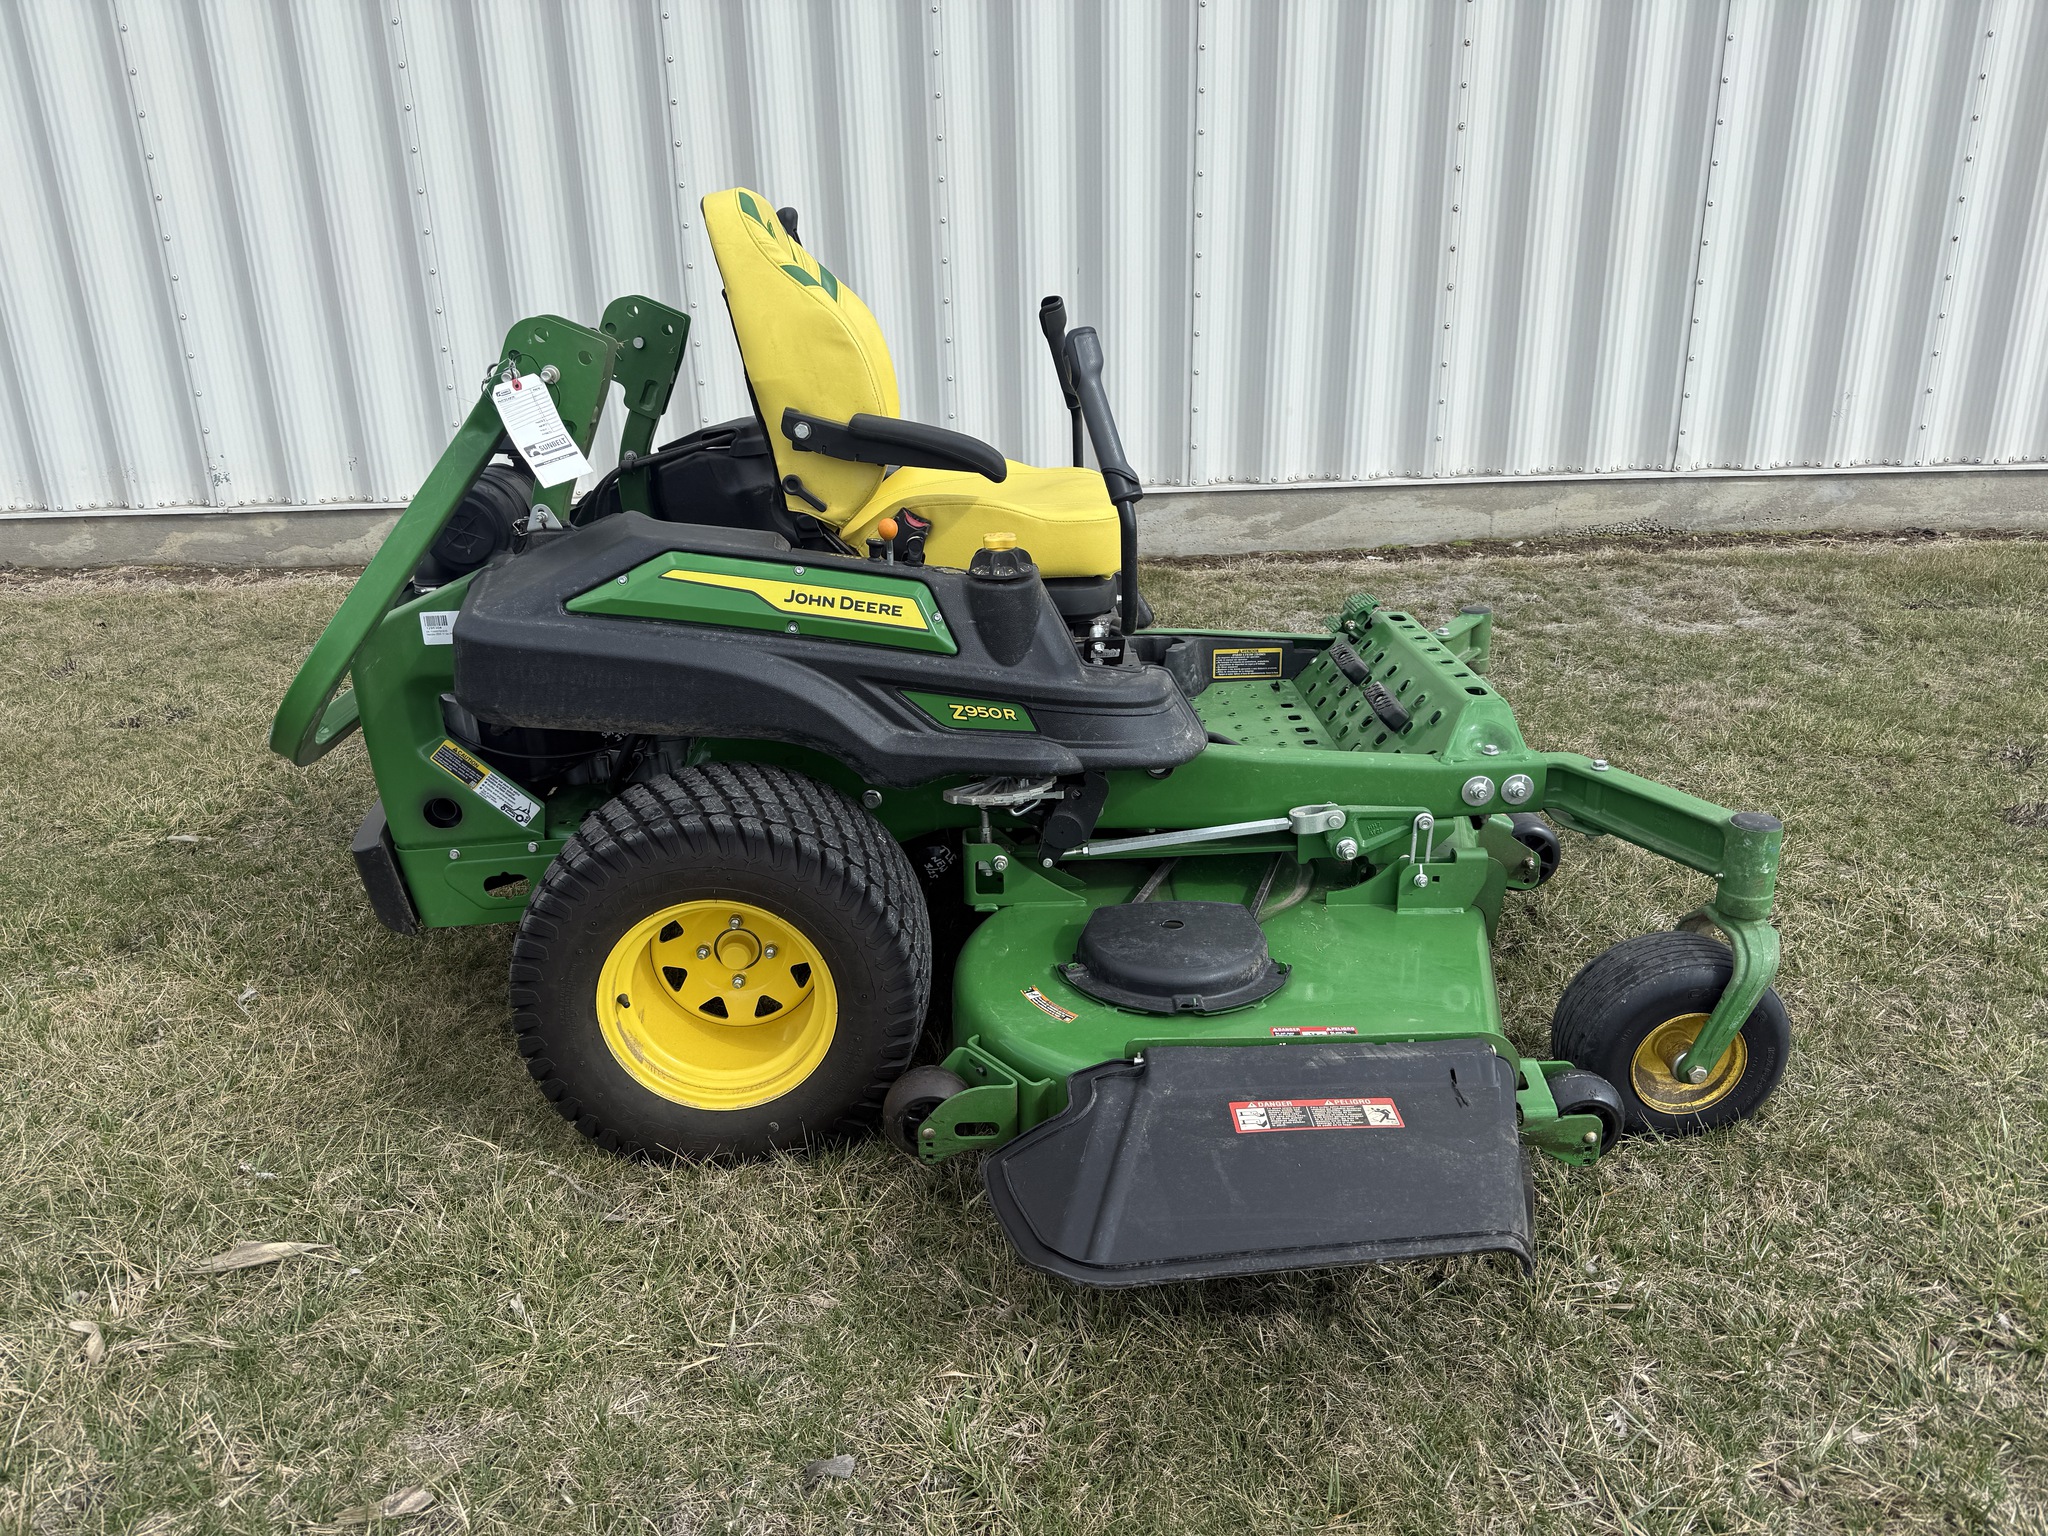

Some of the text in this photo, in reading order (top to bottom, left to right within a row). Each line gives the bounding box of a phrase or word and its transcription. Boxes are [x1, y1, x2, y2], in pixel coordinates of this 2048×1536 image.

[539, 437, 567, 452] SUNBELT
[784, 589, 903, 617] JOHN DEERE
[948, 704, 1018, 721] Z950R
[457, 750, 480, 768] CAUTION
[930, 856, 949, 873] NEW
